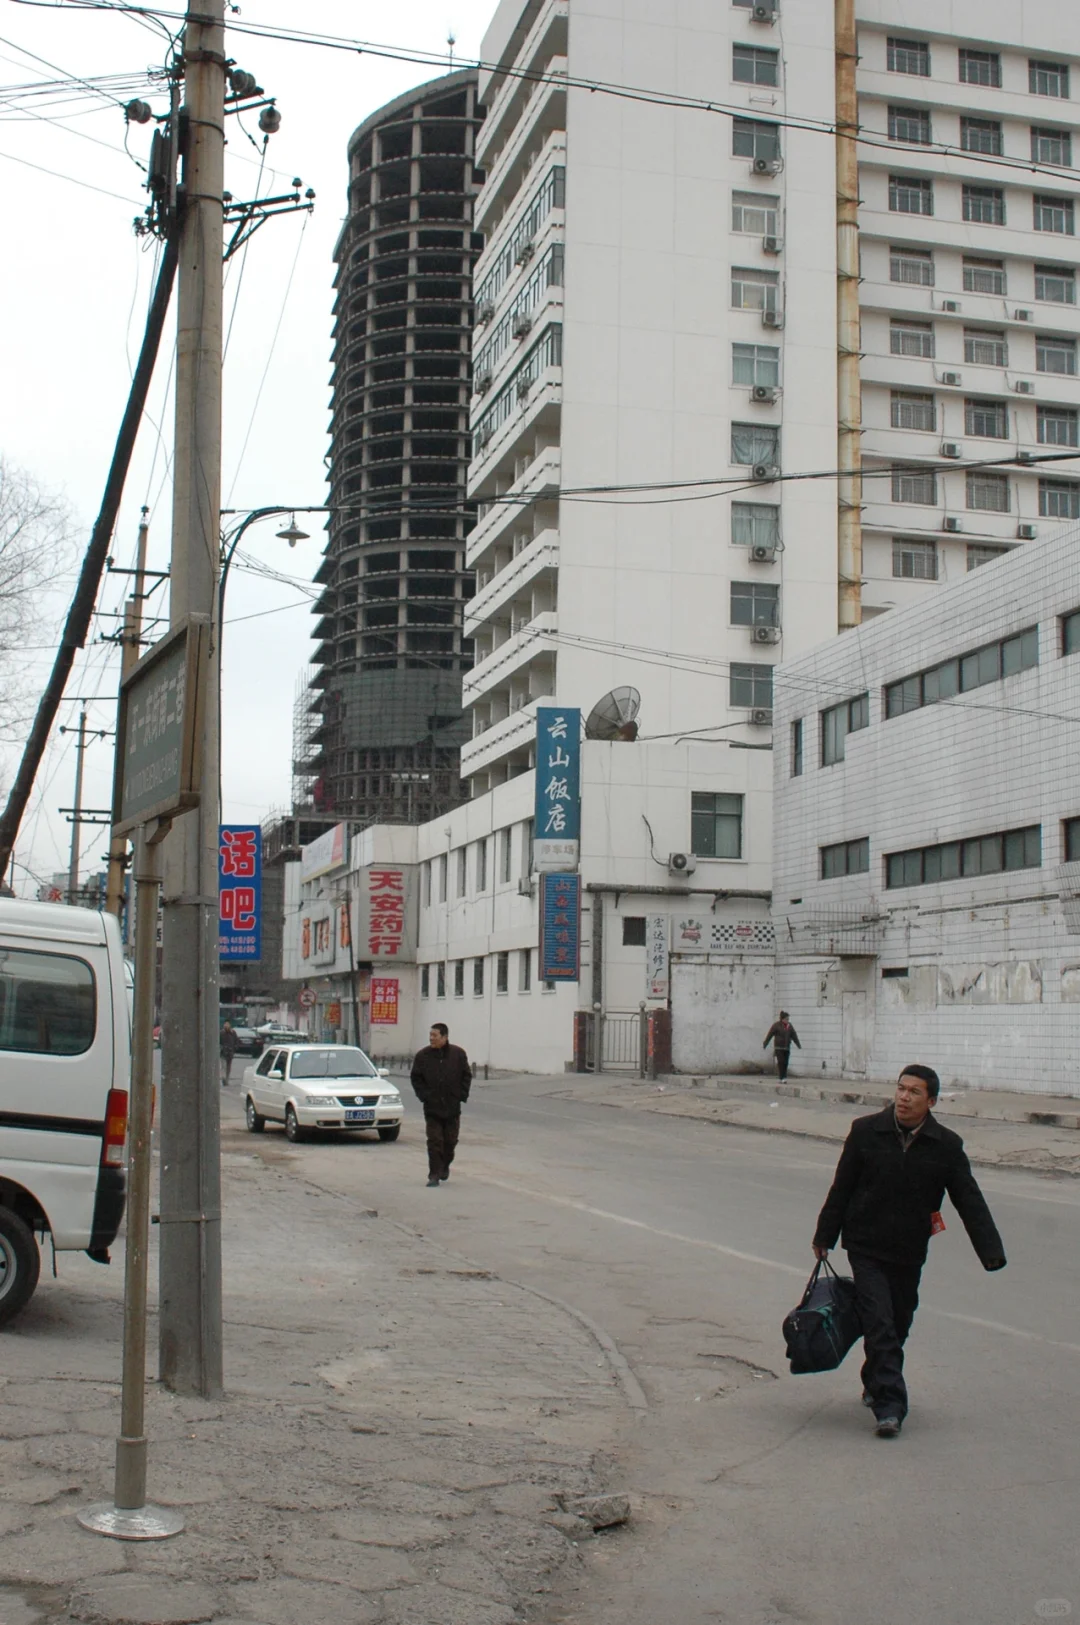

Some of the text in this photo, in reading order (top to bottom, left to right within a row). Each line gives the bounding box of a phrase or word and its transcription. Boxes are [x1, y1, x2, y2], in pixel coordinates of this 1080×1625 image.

[545, 717, 571, 832] 云山饭店
[220, 830, 256, 930] 话吧
[368, 871, 403, 955] 天安药行
[653, 918, 666, 978] 宏达汽修厂
[375, 986, 395, 995] 名片
